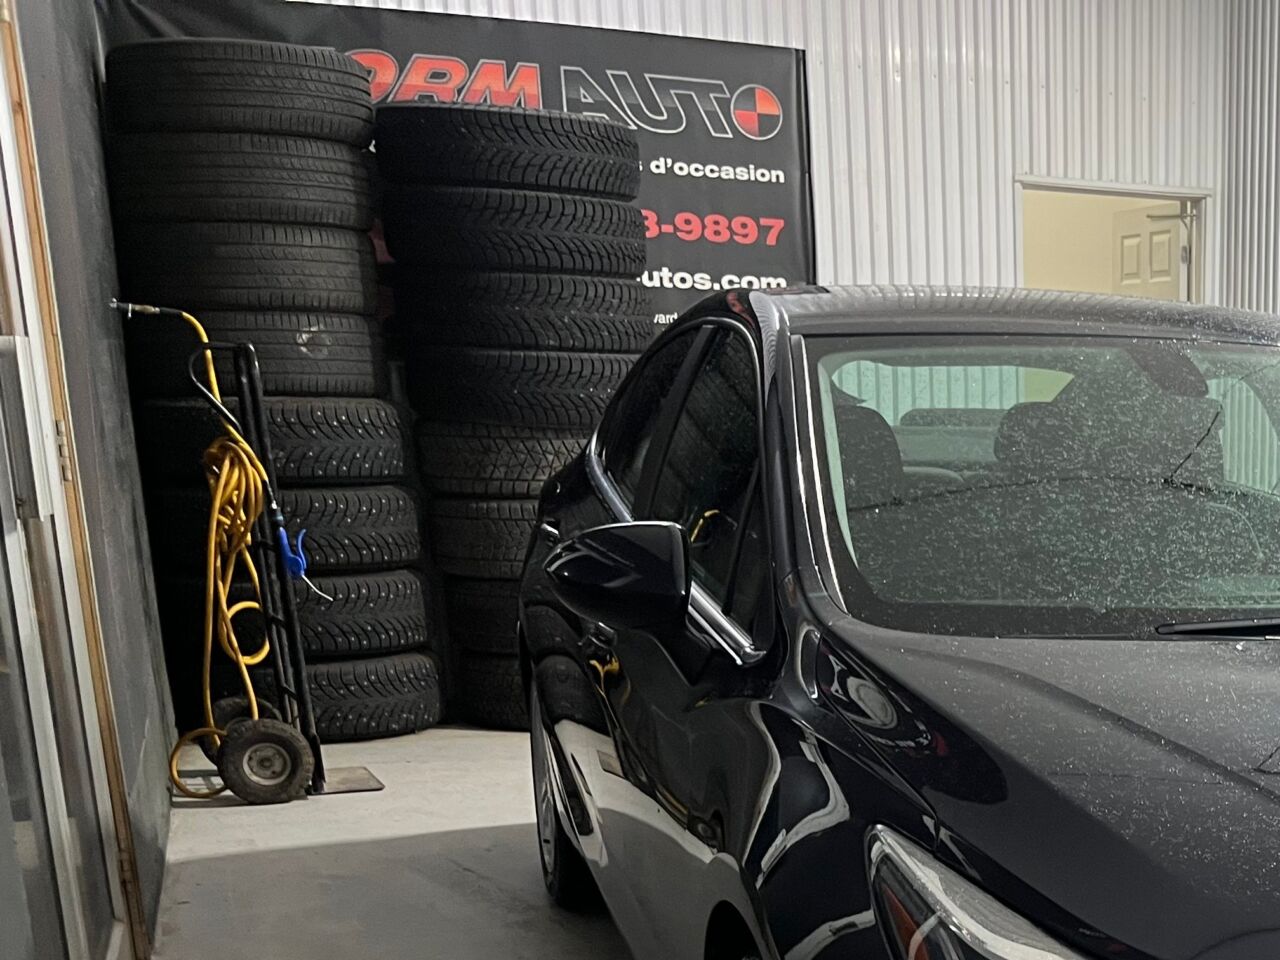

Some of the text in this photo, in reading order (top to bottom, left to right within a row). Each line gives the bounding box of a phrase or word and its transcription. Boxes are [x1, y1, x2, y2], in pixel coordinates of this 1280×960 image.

[560, 65, 783, 140] AUTO
[650, 157, 785, 183] d’occasion
[636, 267, 787, 290] utos.com
